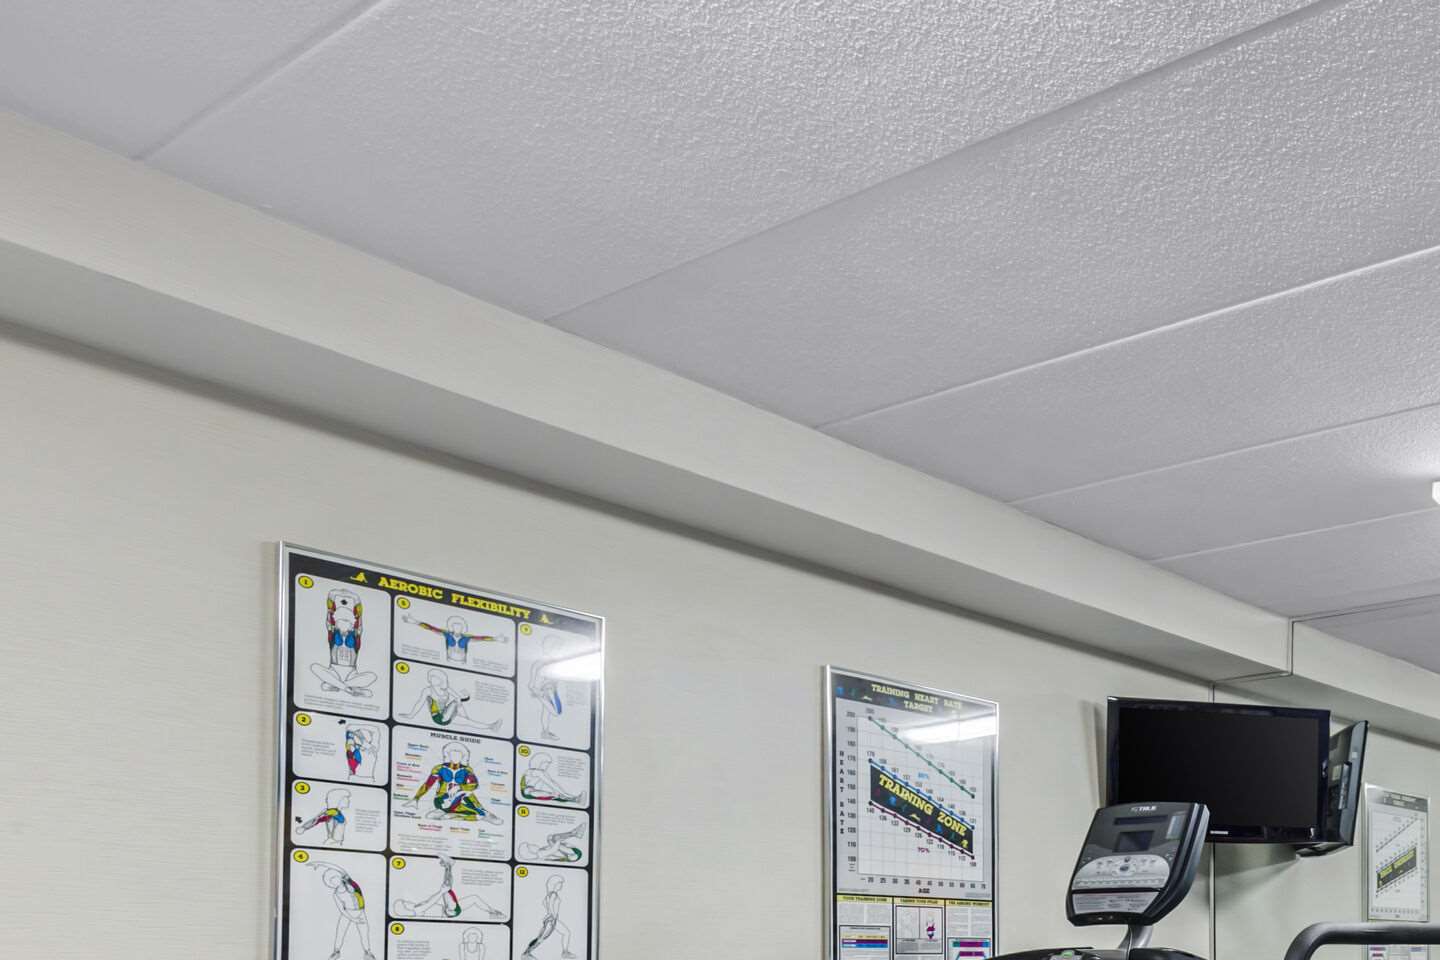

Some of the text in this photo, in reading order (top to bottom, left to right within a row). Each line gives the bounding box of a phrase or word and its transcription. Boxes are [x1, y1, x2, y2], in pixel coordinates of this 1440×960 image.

[378, 576, 532, 620] AEROBIC FLEXIBILITY
[871, 684, 910, 699] TRAINING
[914, 692, 939, 705] HEART
[903, 700, 934, 713] TARGET
[879, 774, 967, 836] TRAINING ZONE
